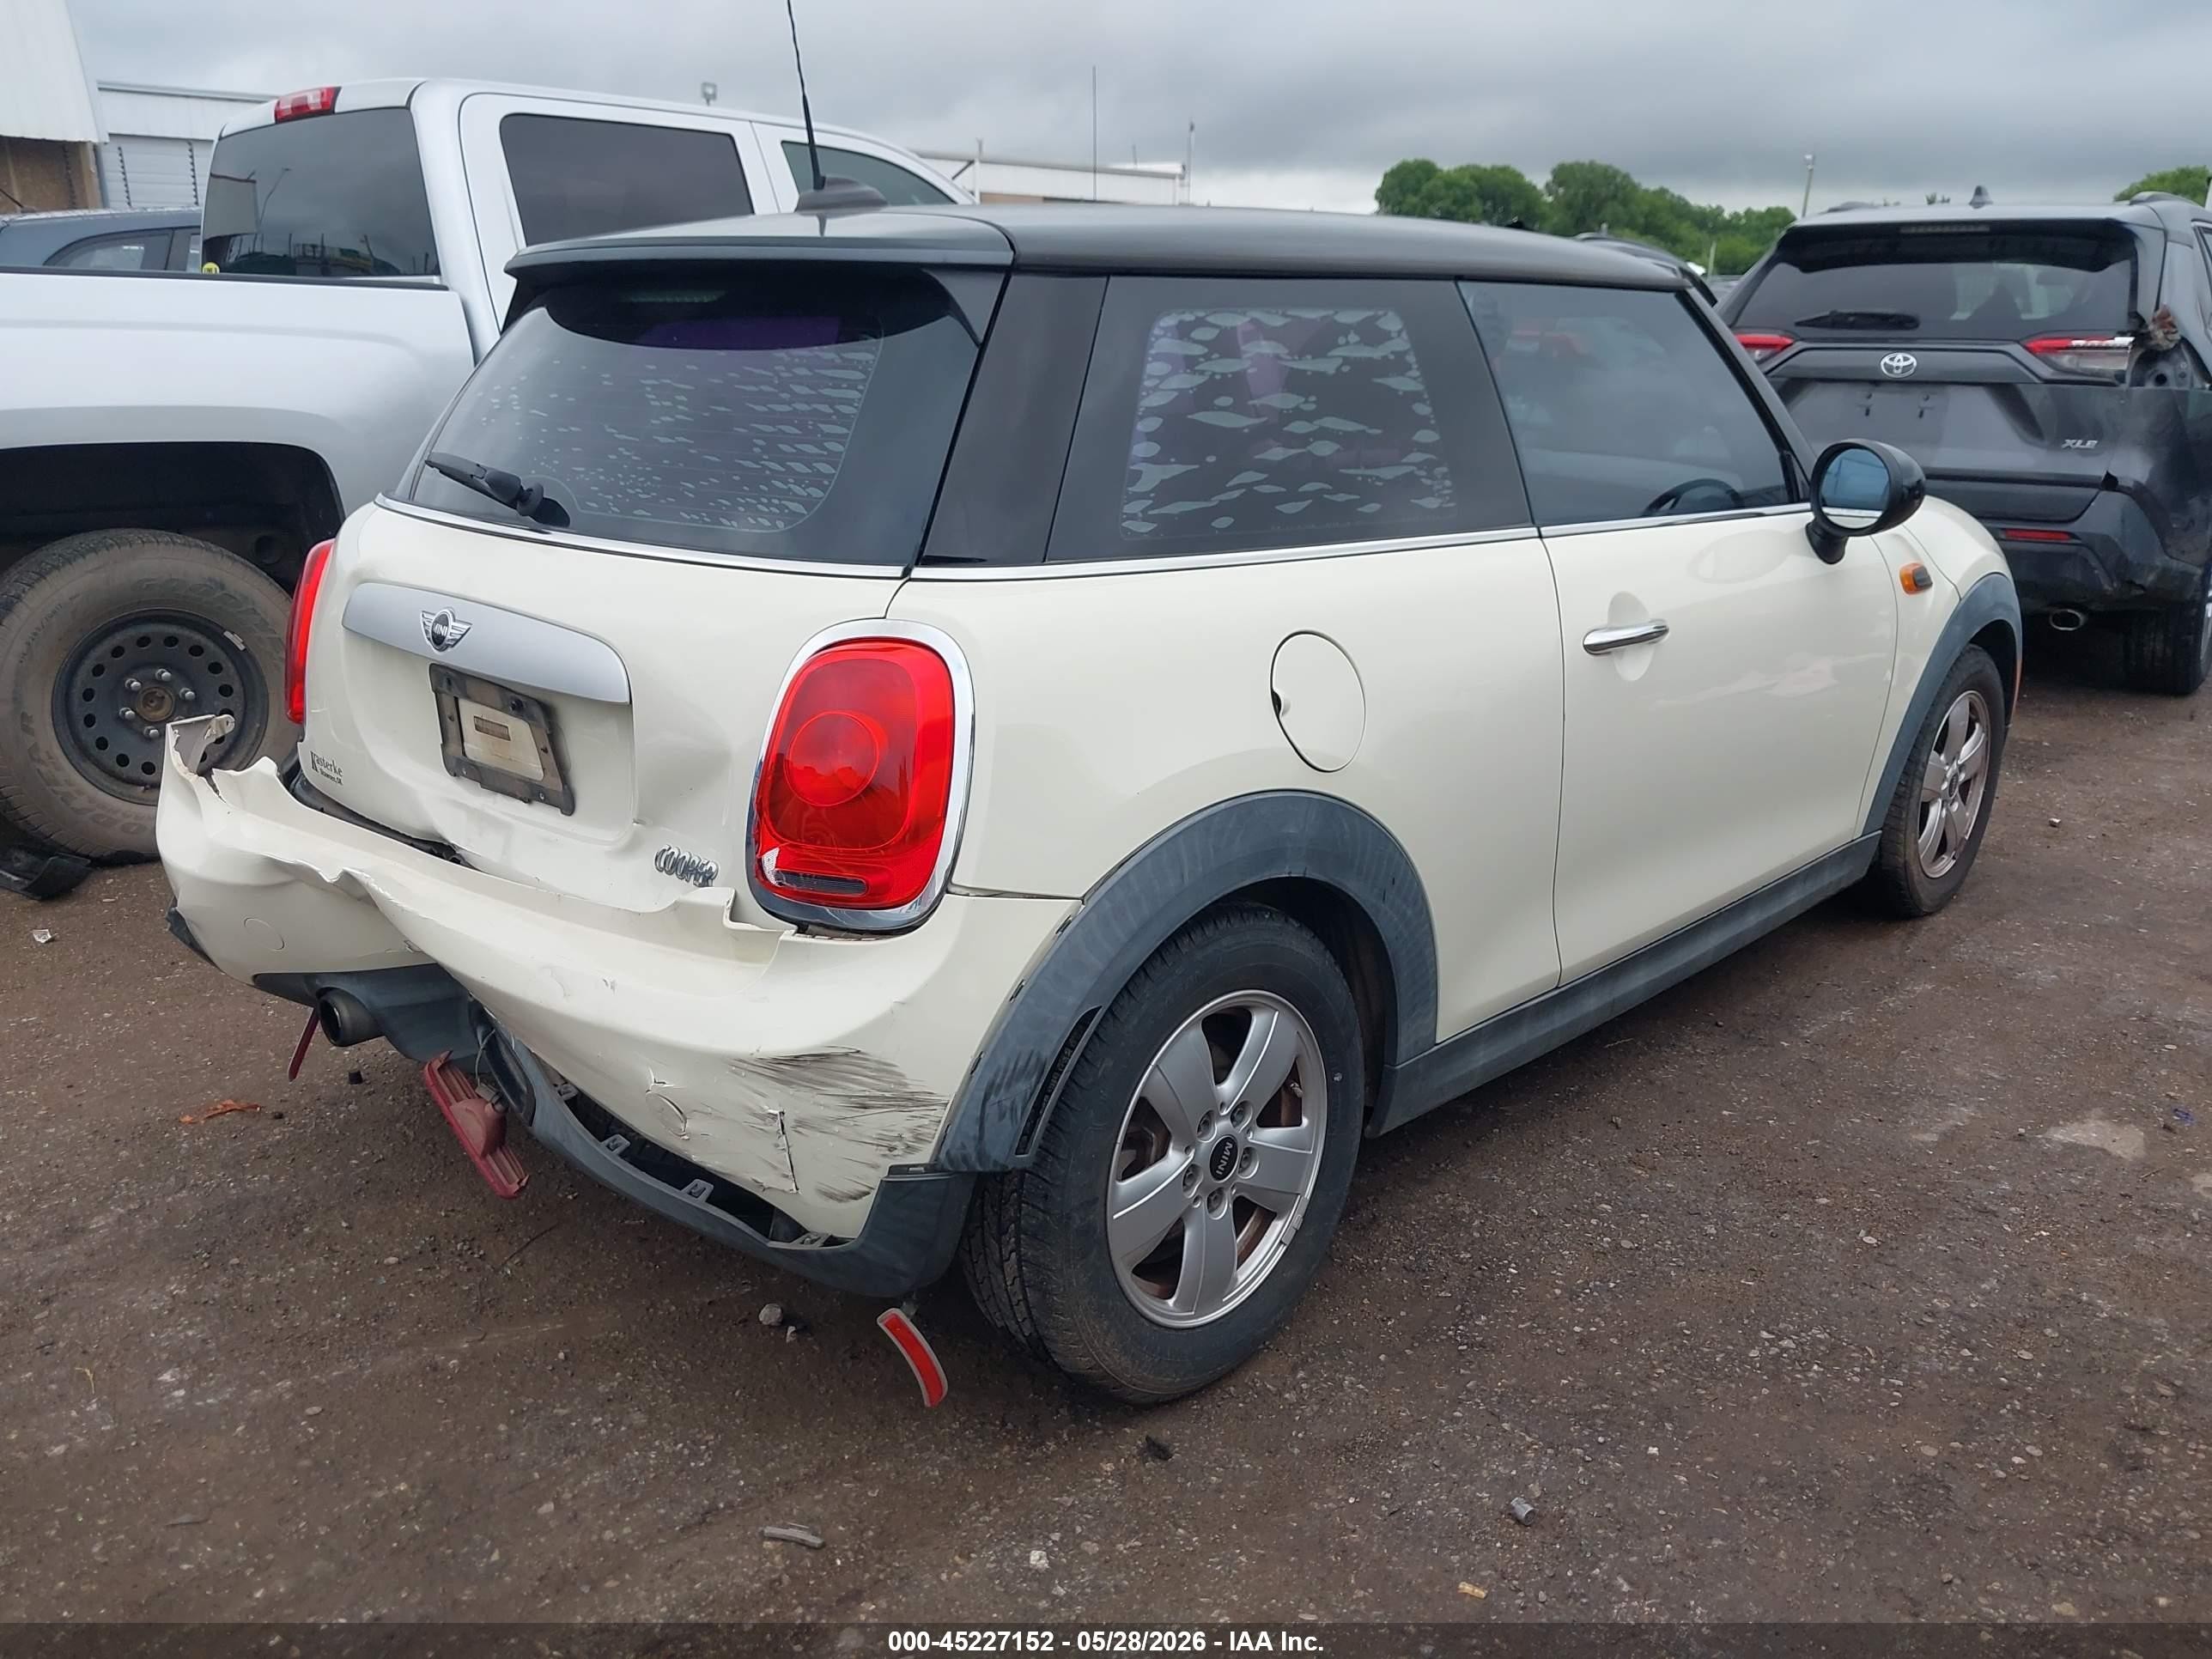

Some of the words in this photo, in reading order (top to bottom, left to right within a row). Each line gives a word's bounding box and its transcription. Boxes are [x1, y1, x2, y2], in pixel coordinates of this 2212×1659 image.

[2061, 439, 2098, 448] XLE
[654, 844, 719, 887] COOPER
[1215, 1141, 1233, 1176] MINI
